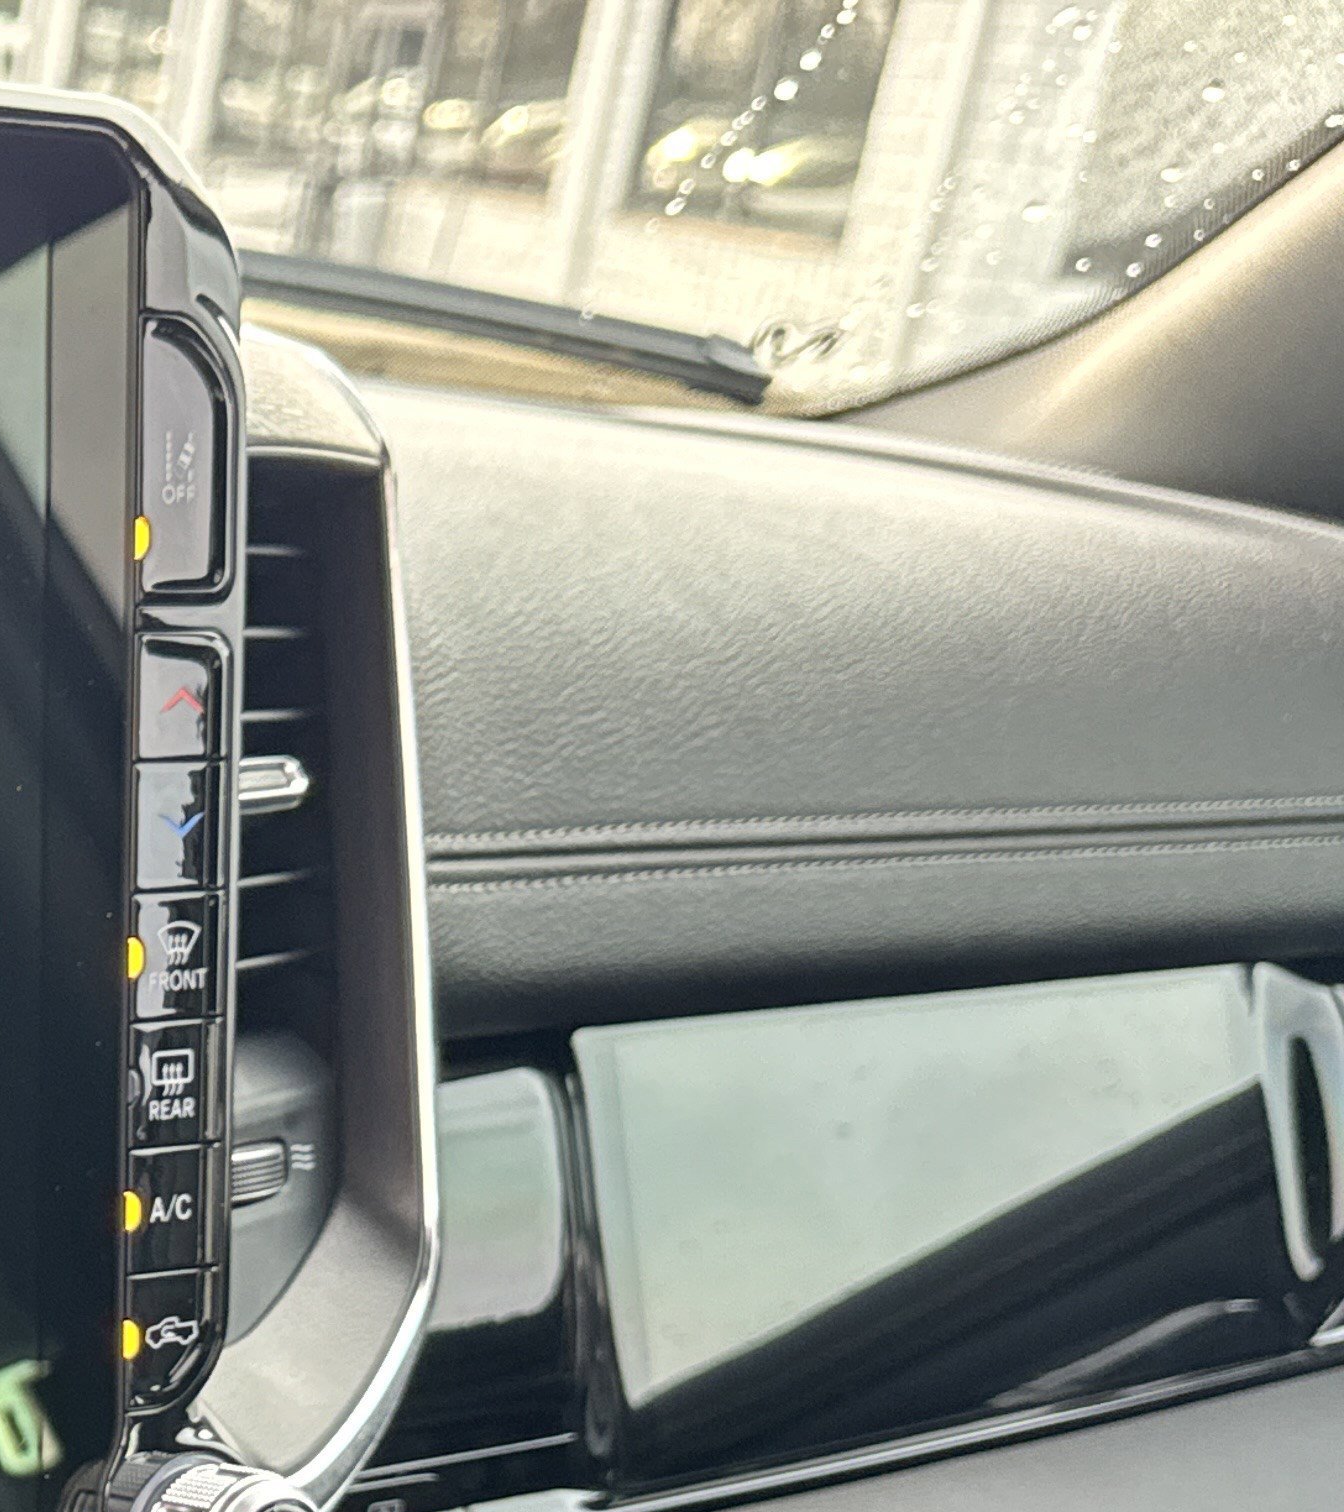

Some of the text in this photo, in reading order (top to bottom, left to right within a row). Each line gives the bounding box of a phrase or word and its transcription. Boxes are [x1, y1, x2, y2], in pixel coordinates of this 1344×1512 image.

[161, 484, 197, 504] OFF
[148, 967, 208, 992] FRONT
[148, 1097, 195, 1121] REAR
[149, 1194, 192, 1223] A/C
